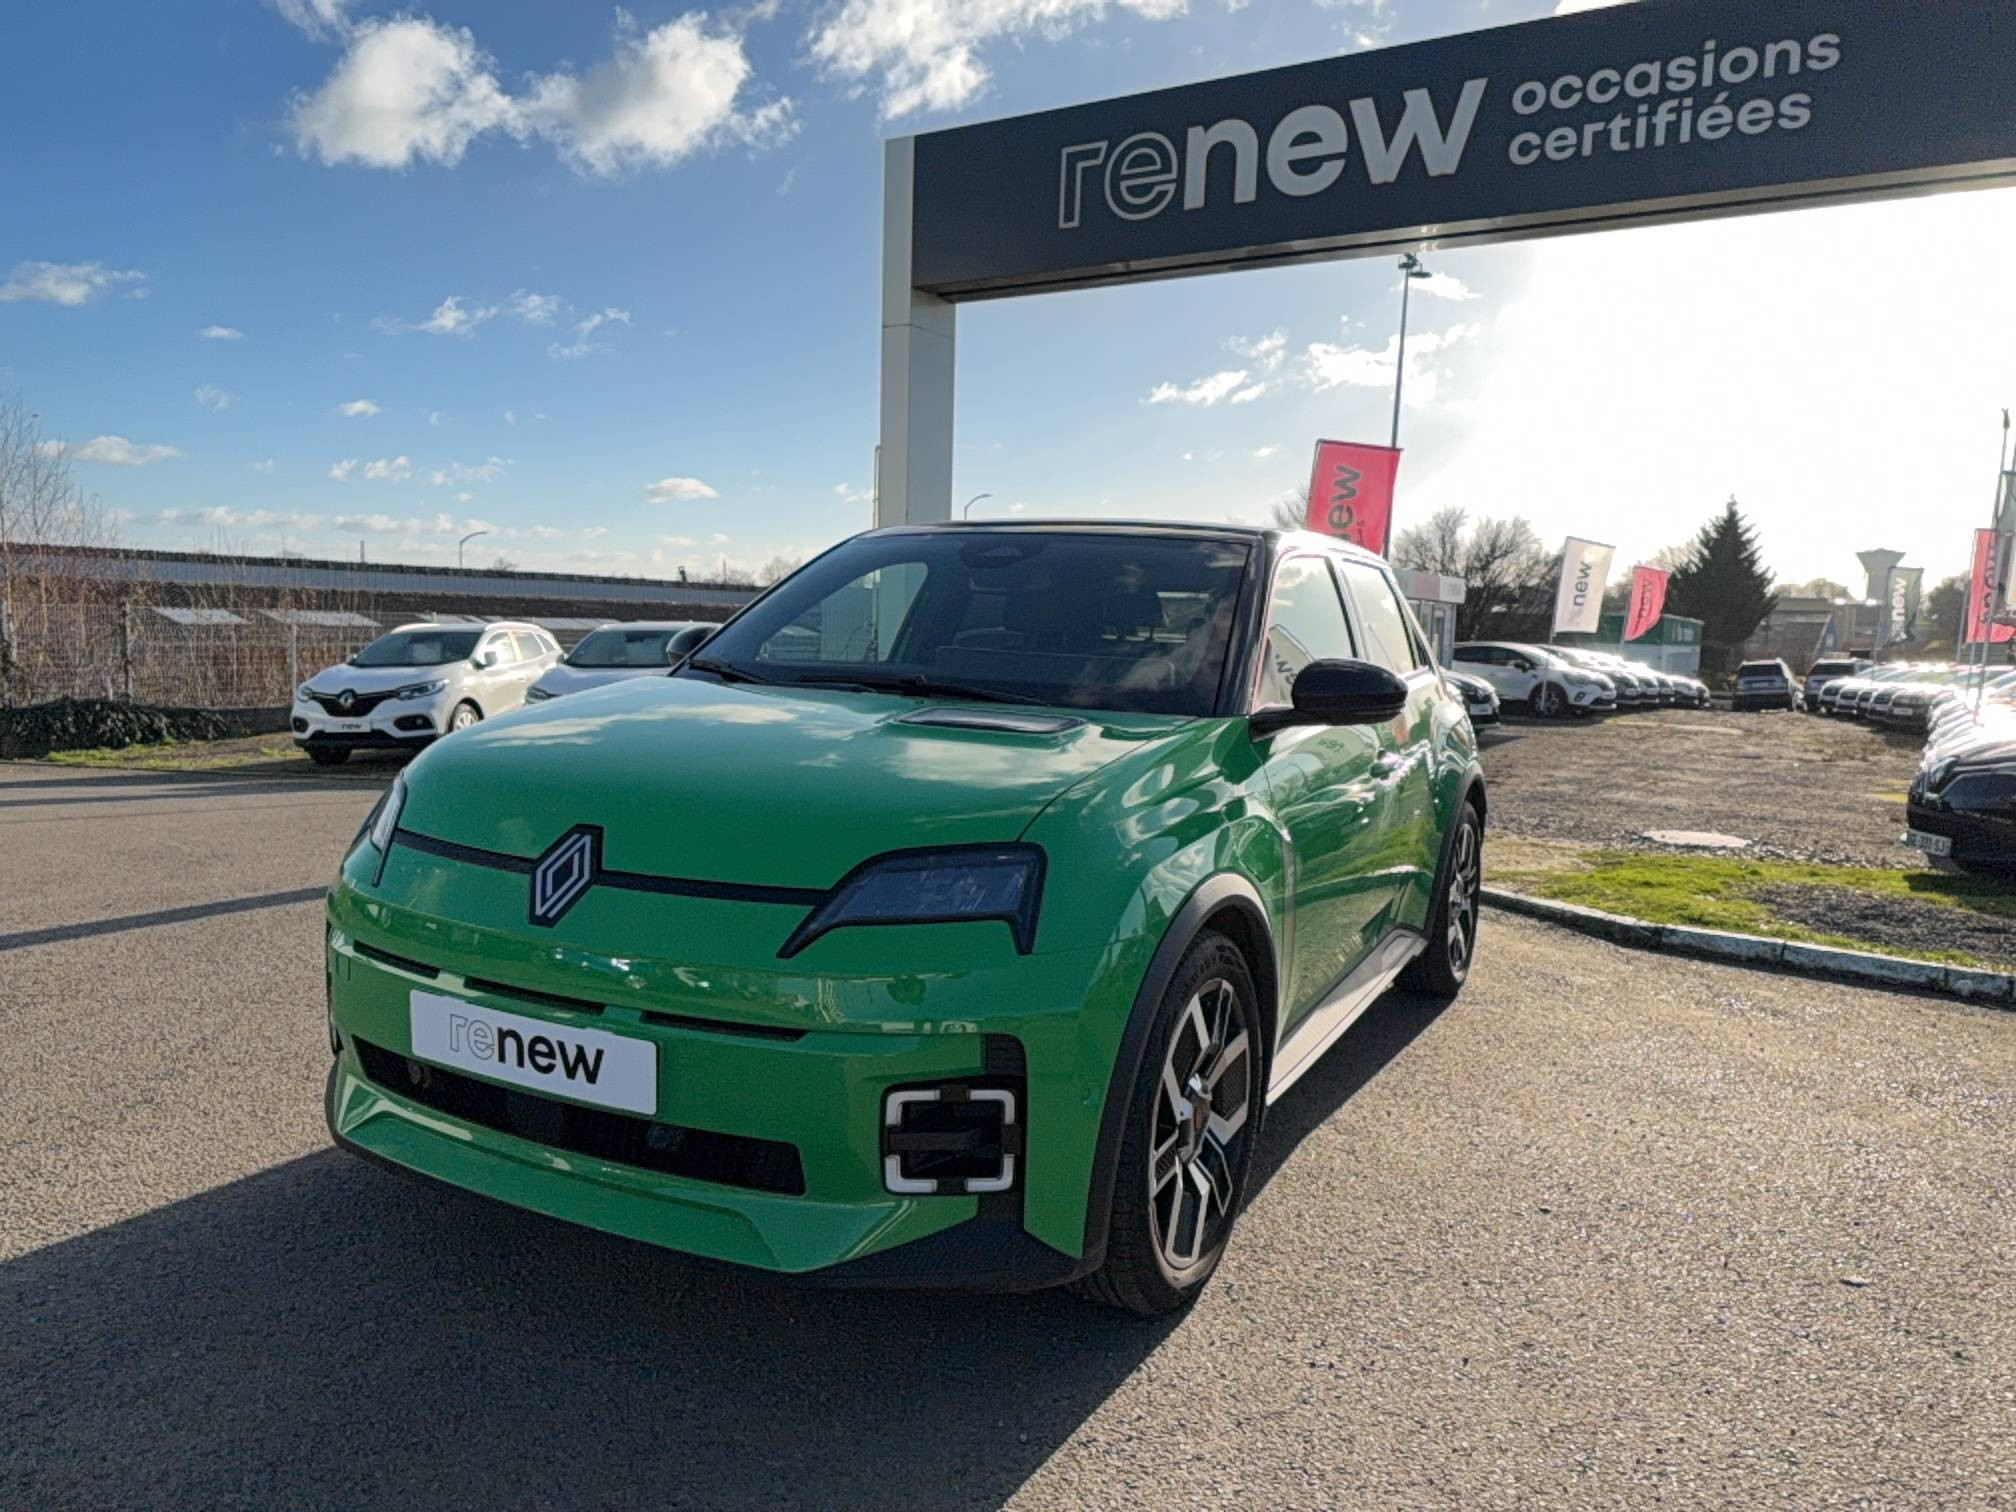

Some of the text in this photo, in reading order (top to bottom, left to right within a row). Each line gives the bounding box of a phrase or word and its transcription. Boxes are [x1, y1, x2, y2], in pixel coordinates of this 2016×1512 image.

[1512, 33, 1841, 115] occasions
[1058, 77, 1489, 228] renew
[1508, 91, 1812, 165] certifiées
[450, 1013, 604, 1084] renew
